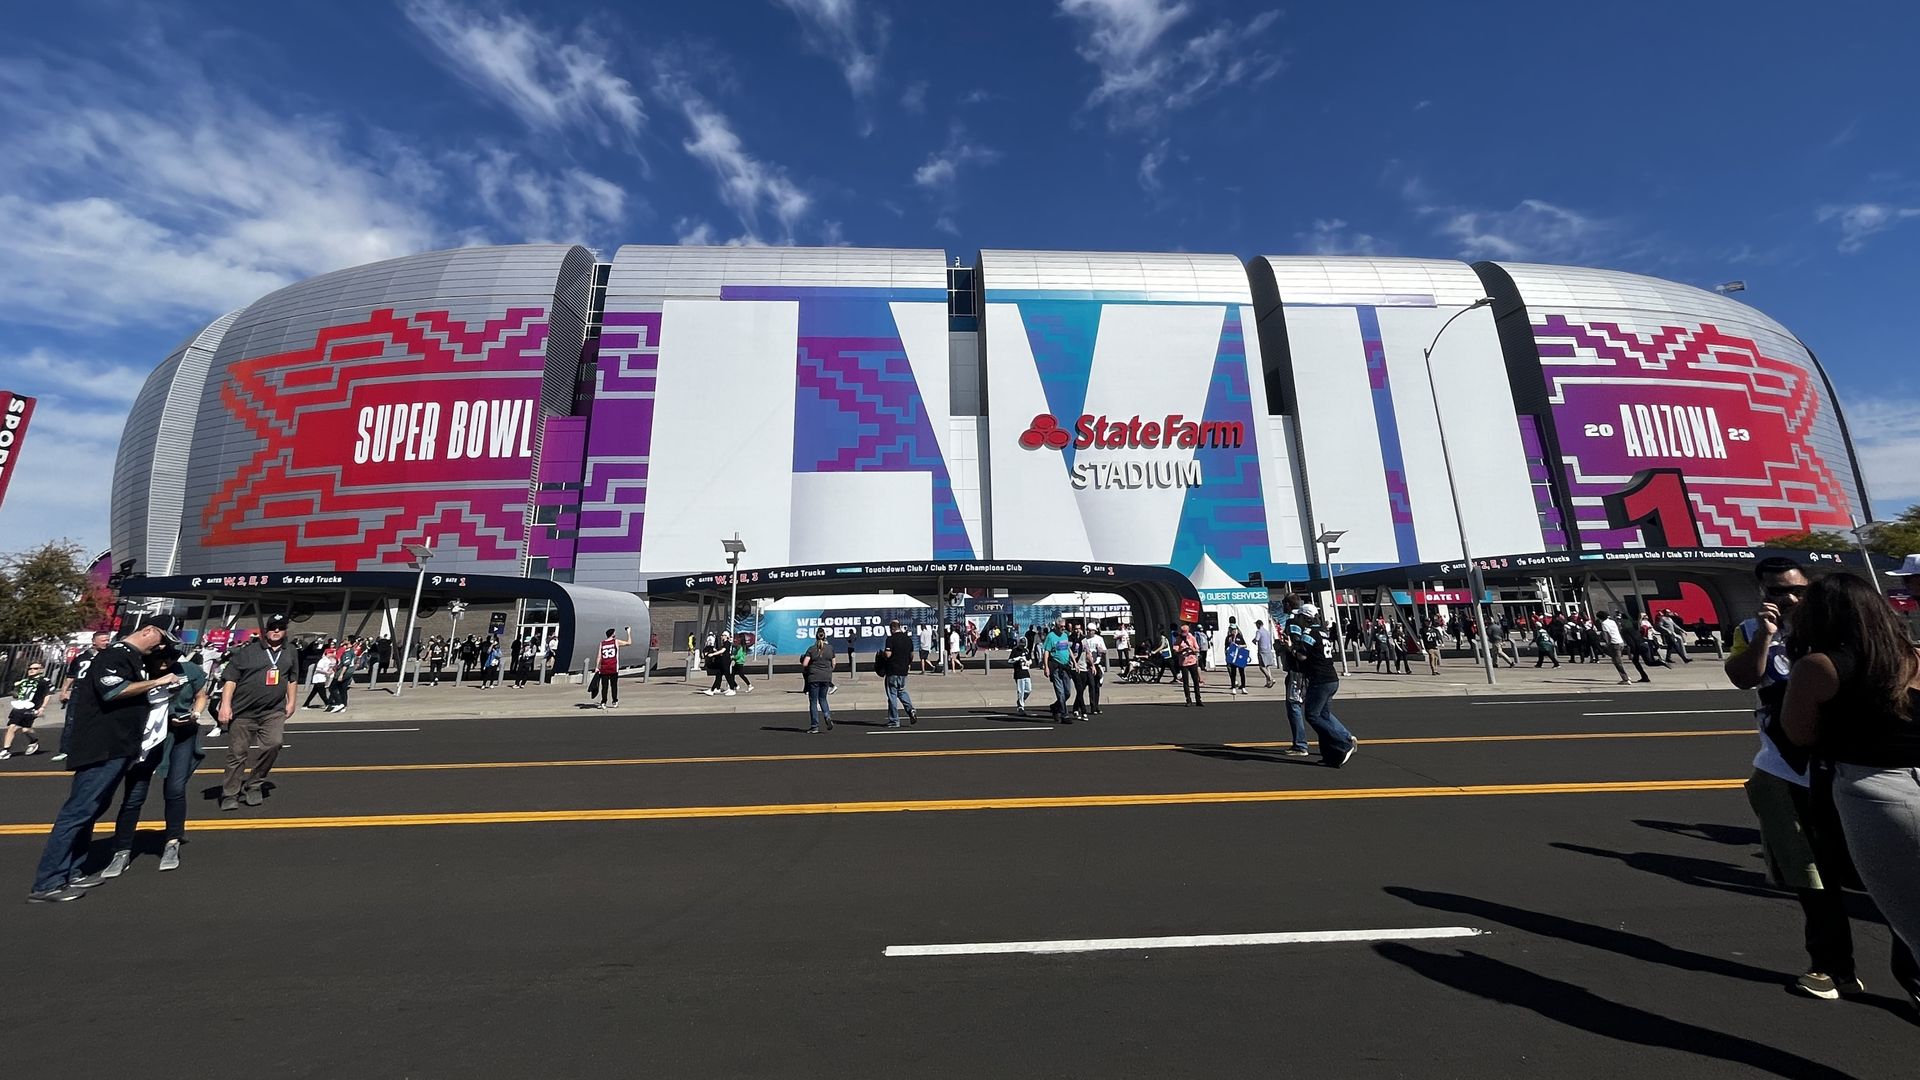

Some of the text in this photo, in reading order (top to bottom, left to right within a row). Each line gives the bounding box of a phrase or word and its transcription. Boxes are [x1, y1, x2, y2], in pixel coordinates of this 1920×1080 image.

[354, 400, 533, 464] SUPER BOWL
[1584, 404, 1750, 459] 20 ARIZONA 23
[0, 398, 25, 479] SPOR
[1071, 460, 1202, 489] STADIUM
[1528, 555, 1570, 565] Food Trucks
[1606, 552, 1643, 560] Champions
[1644, 551, 1660, 559] Club
[1666, 551, 1682, 559] Club
[1683, 551, 1692, 559] 57
[1699, 551, 1738, 559] Touchdown
[780, 569, 826, 579] Food Trucks
[865, 565, 905, 574] Touchdown
[907, 565, 923, 573] Club
[930, 564, 947, 572] Club
[965, 564, 1005, 572] Champions
[294, 575, 342, 584] Food Trucks
[1206, 591, 1268, 600] GUEST SERVICES
[1426, 593, 1460, 601] GATE 1
[986, 603, 1004, 611] FIFTY
[796, 616, 881, 627] WELCOME TO
[602, 648, 615, 659] 33
